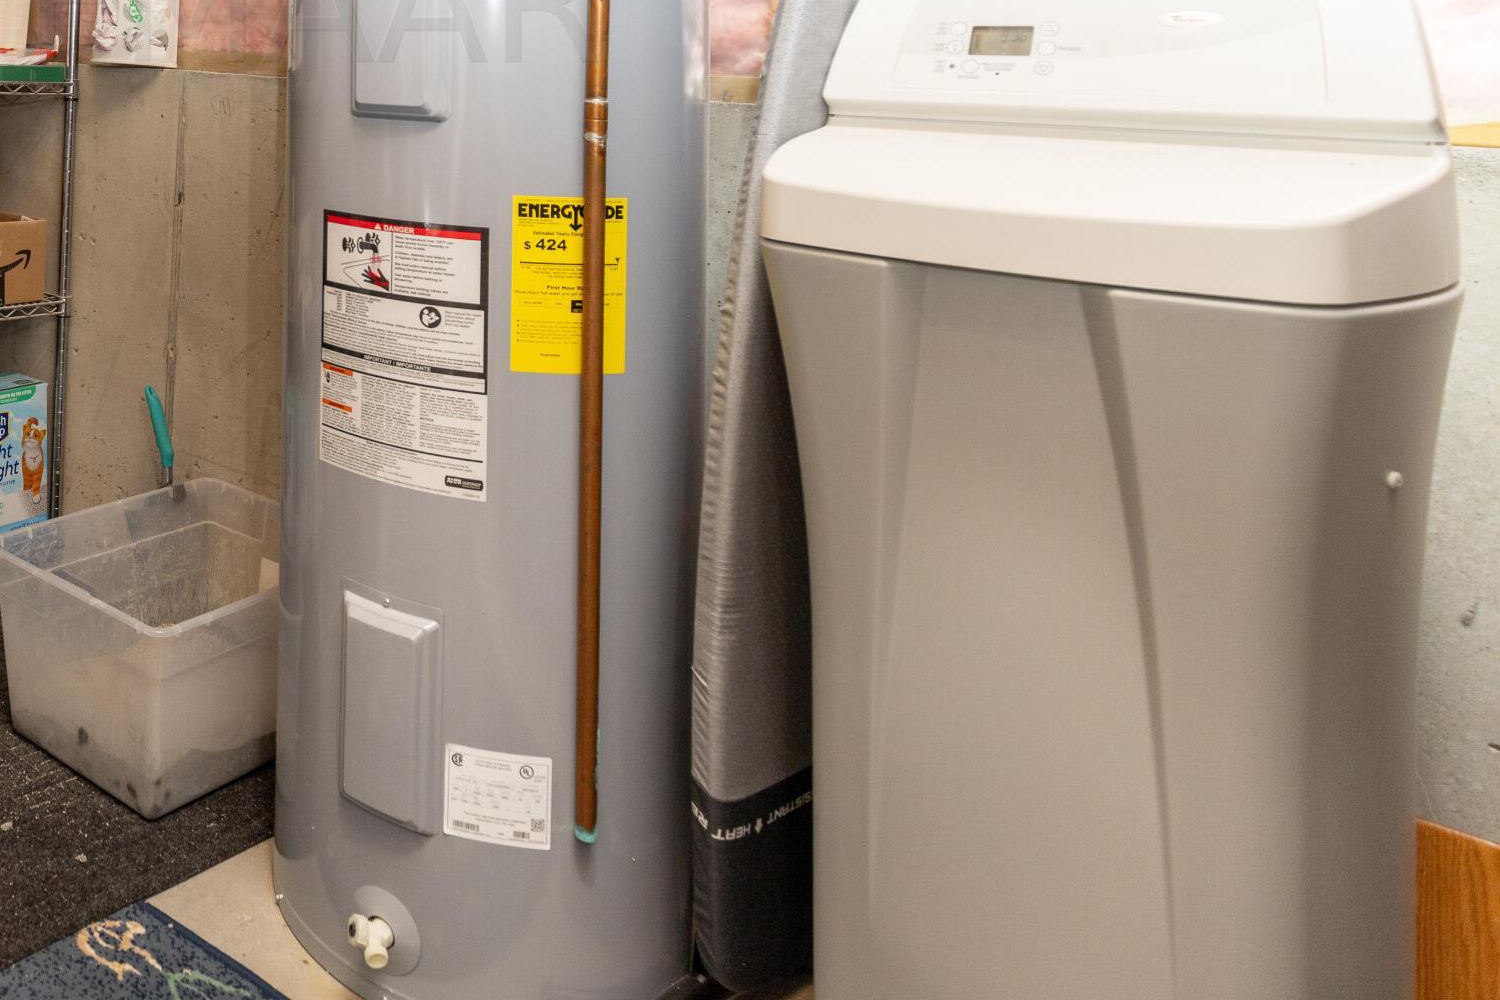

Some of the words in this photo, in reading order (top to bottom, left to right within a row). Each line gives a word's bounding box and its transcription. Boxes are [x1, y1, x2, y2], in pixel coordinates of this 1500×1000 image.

[383, 224, 415, 234] DANGER
[535, 239, 567, 251] 424
[364, 355, 393, 366] IMPORTANT
[396, 360, 431, 372] IMPORTANTE
[767, 791, 812, 824] SISTANT
[711, 823, 751, 840] HEAT
